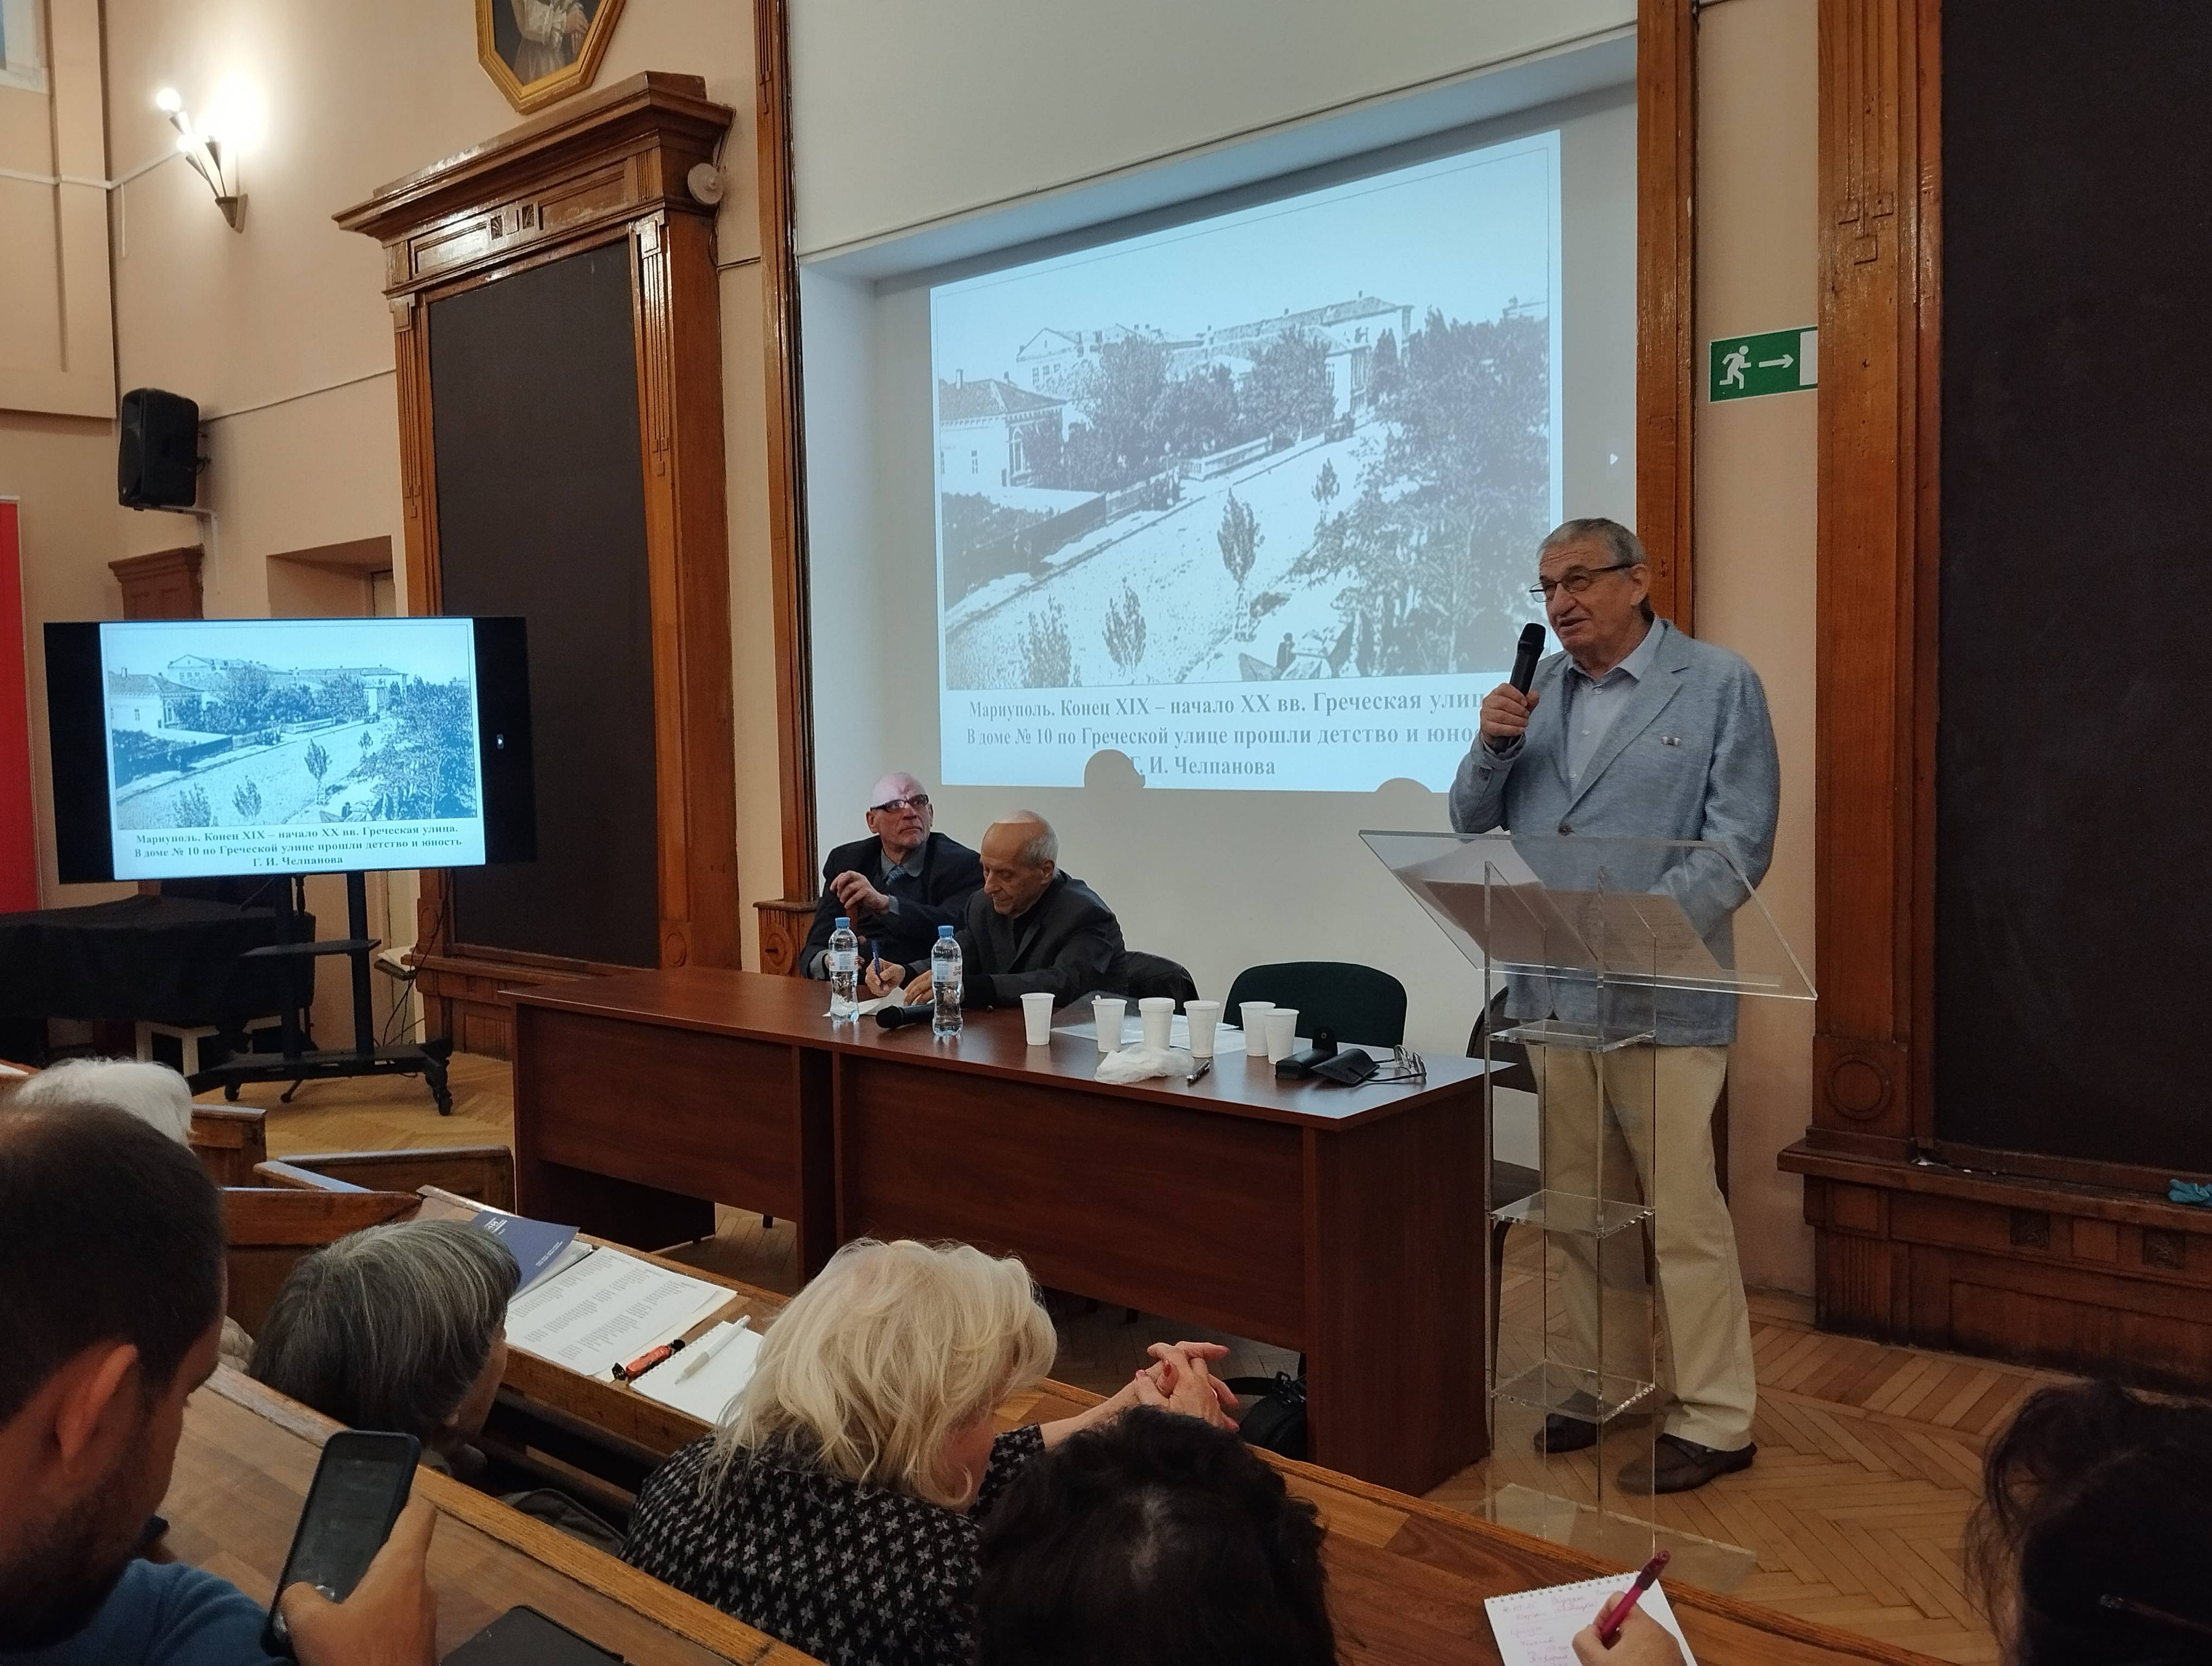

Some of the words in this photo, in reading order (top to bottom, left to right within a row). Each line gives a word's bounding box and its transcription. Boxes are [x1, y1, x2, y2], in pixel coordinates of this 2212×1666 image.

[970, 702, 1055, 721] Мариуполь.
[1061, 700, 1110, 717] Конец
[1116, 698, 1149, 715] XIX
[1171, 700, 1234, 714] начало
[1241, 694, 1270, 713] XX
[1278, 698, 1306, 712] вв.
[1314, 693, 1421, 716] Греческая
[1429, 694, 1484, 714] улиц
[967, 728, 975, 744] В
[979, 732, 1011, 746] доме
[1015, 728, 1031, 744] №
[1038, 728, 1052, 744] 10
[1058, 732, 1076, 744] по
[1082, 727, 1168, 748] Греческой
[1174, 731, 1227, 748] улице
[1233, 729, 1311, 748] прошли
[1317, 728, 1398, 745] детство
[1407, 728, 1418, 742] и
[1150, 757, 1168, 773] И.
[1175, 757, 1275, 774] Челпанова
[137, 835, 201, 845] Мариуполь.
[205, 832, 239, 841] Конец
[242, 831, 265, 840] XIX
[279, 830, 318, 838] начало
[321, 828, 339, 837] XX
[363, 827, 419, 837] Греческая
[422, 826, 458, 835] улица.
[135, 849, 141, 857] В
[144, 849, 168, 857] доме
[172, 848, 183, 856] №
[189, 847, 199, 855] 10
[220, 844, 278, 856] Греческой
[281, 844, 314, 854] улице
[318, 842, 362, 853] прошли
[365, 841, 408, 850] детство
[253, 858, 262, 867] Г.
[266, 857, 278, 866] И.
[282, 856, 343, 866] Челпанова
